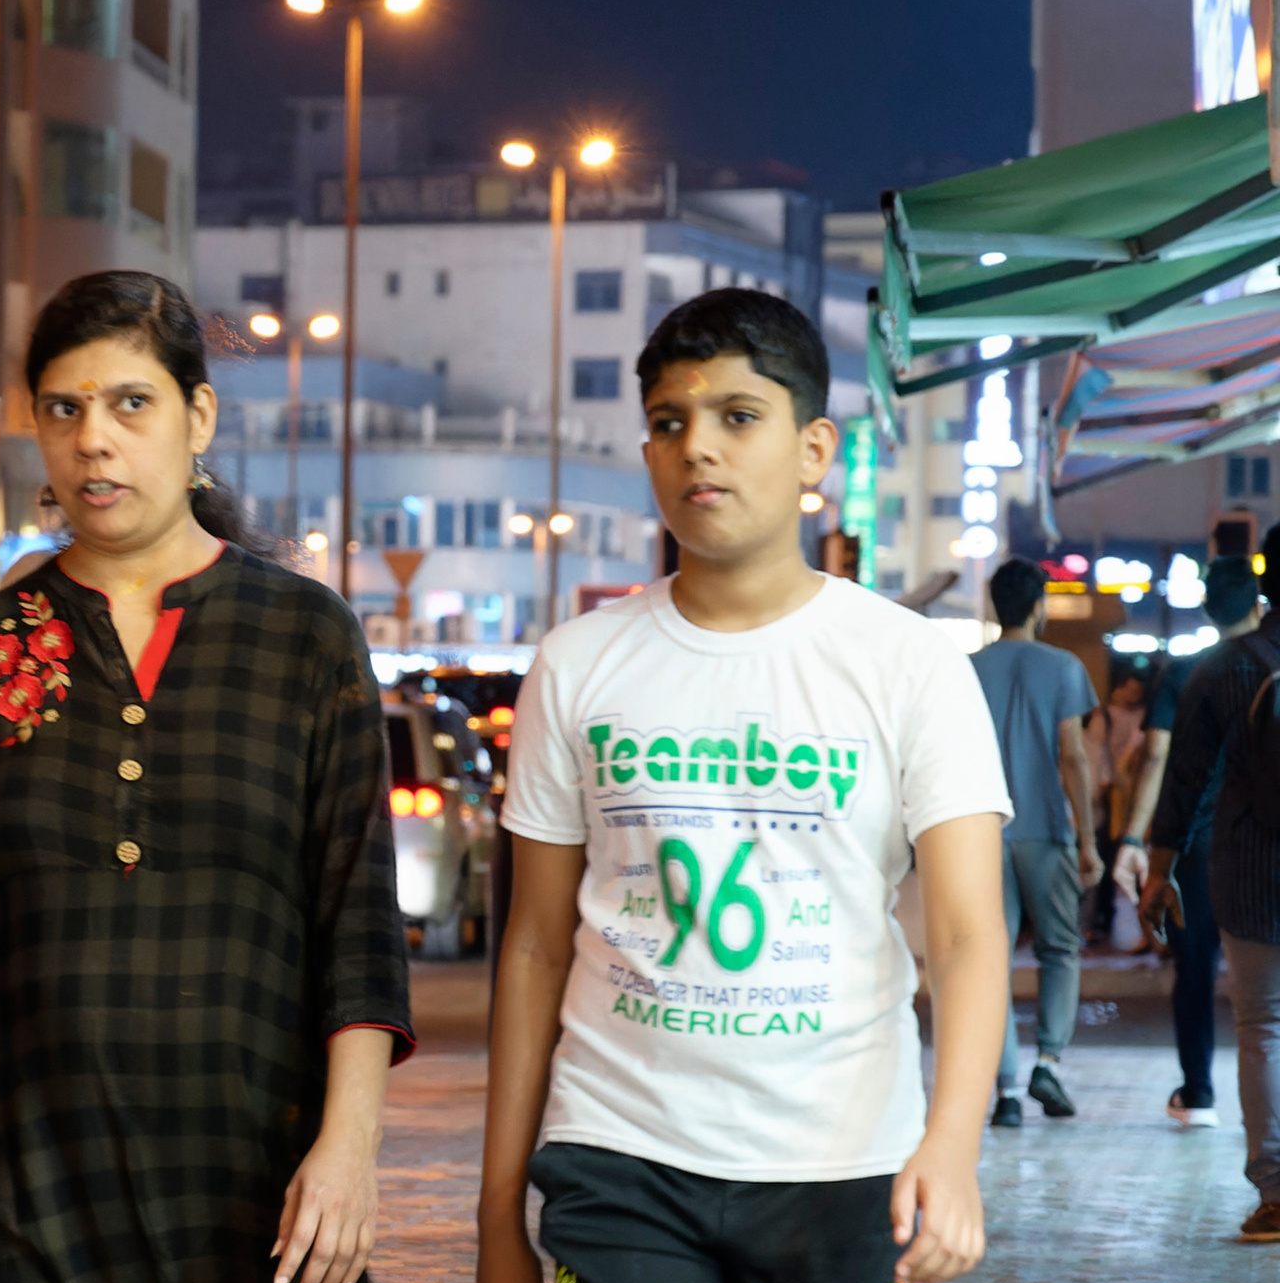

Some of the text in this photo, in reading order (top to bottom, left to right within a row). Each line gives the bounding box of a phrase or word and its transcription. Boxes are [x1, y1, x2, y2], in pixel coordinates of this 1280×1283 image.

[588, 723, 859, 810] Teamboy
[656, 837, 766, 972] 96
[787, 895, 832, 927] And
[611, 992, 822, 1036] AMERICAN
[692, 985, 741, 1007] THAT
